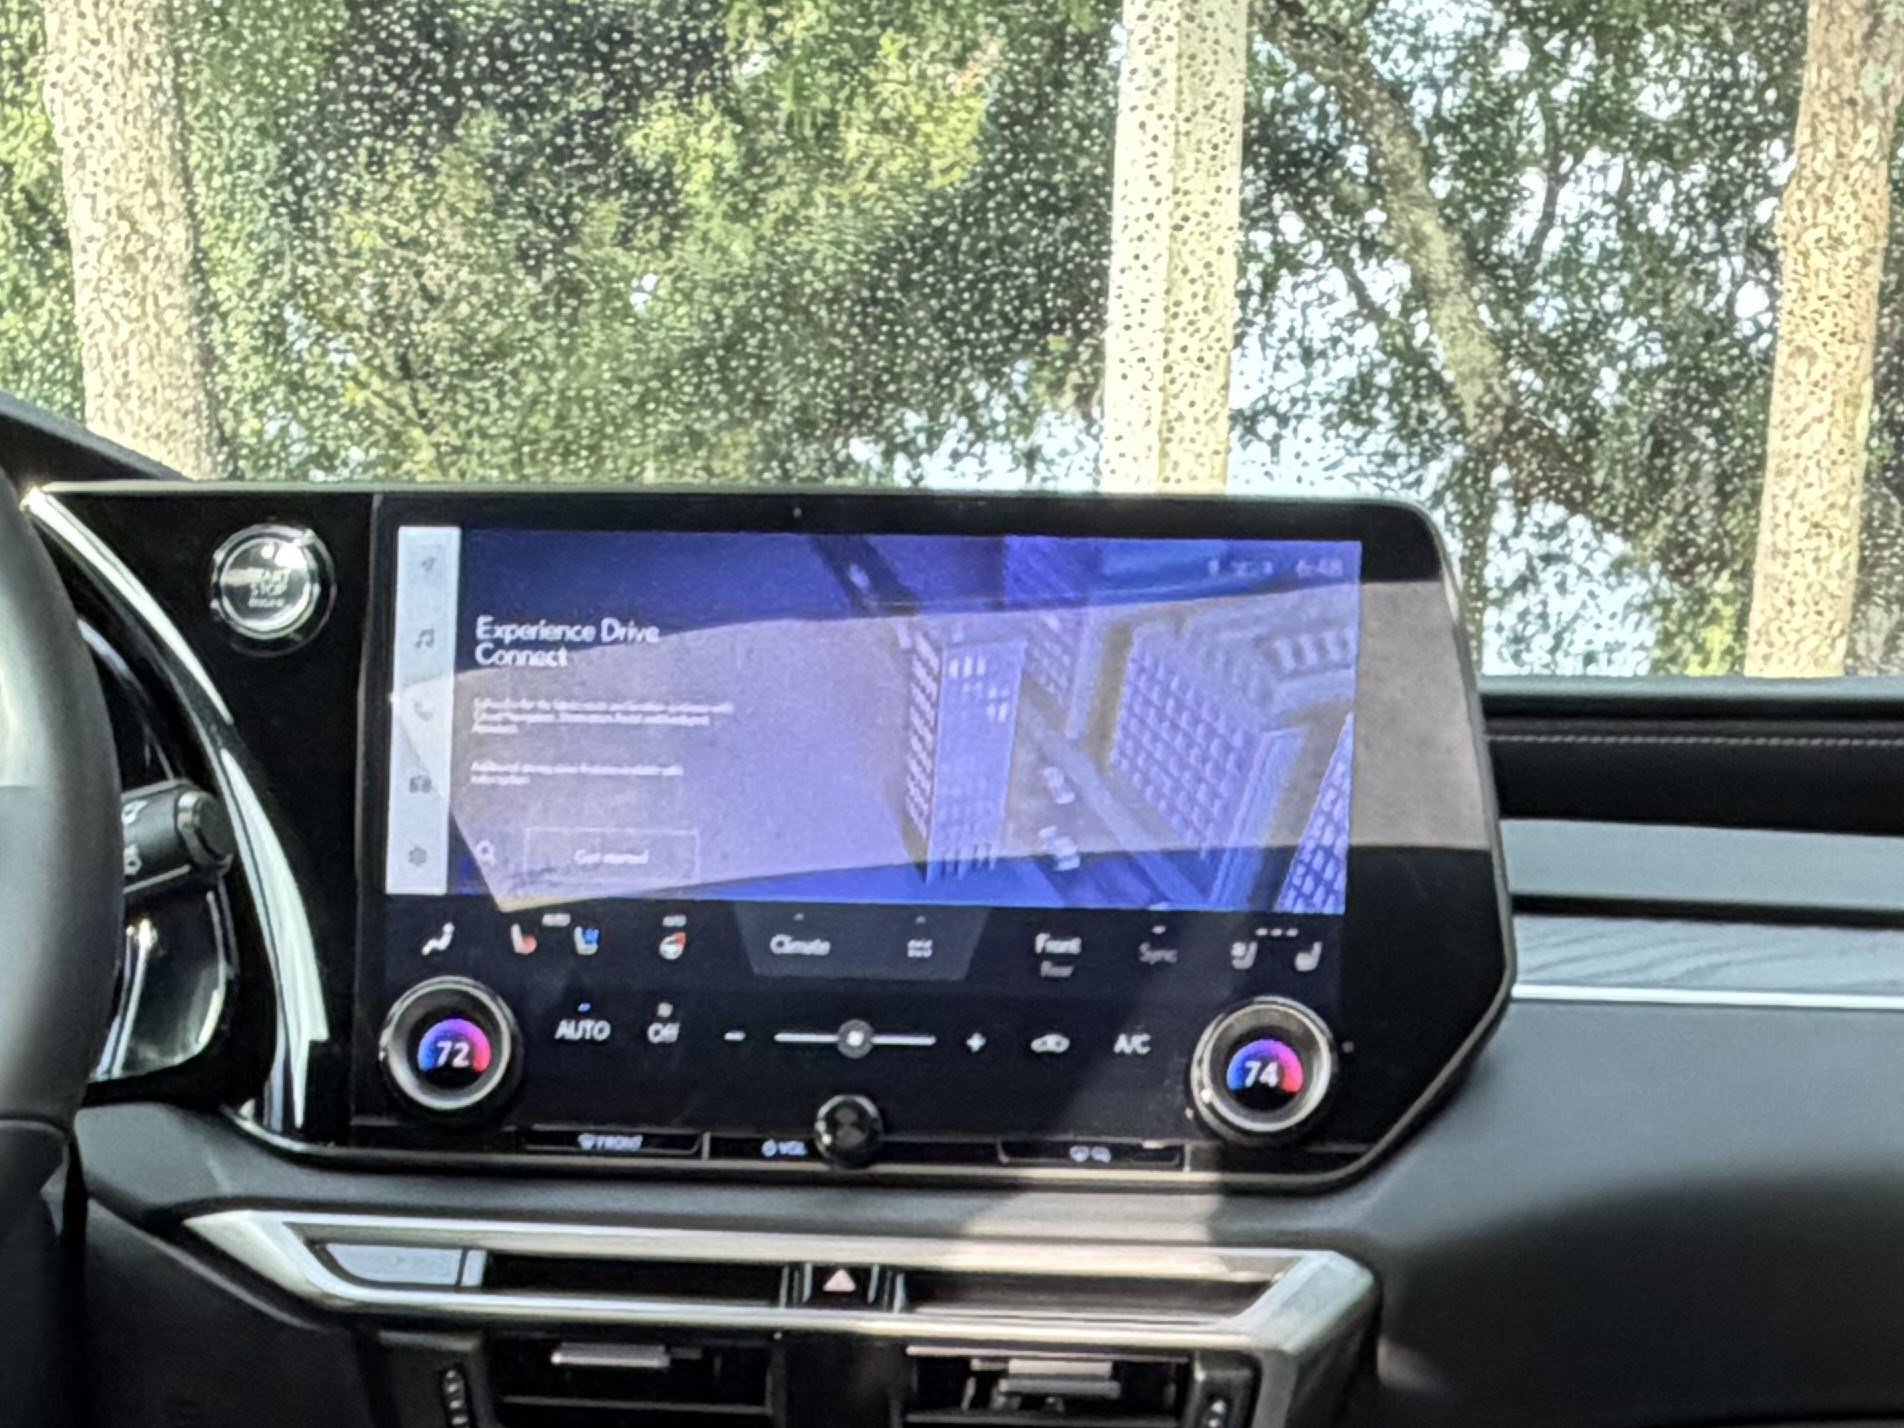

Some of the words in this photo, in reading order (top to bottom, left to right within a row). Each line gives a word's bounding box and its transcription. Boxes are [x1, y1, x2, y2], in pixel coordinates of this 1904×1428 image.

[475, 615, 596, 644] Experience
[600, 617, 660, 643] Drive
[475, 642, 568, 667] Connect
[1034, 932, 1082, 955] Front
[555, 1018, 612, 1042] AUTO
[647, 1022, 681, 1045] Off
[435, 1040, 471, 1068] 72
[1113, 1033, 1152, 1056] A/C
[1244, 1060, 1279, 1088] 74
